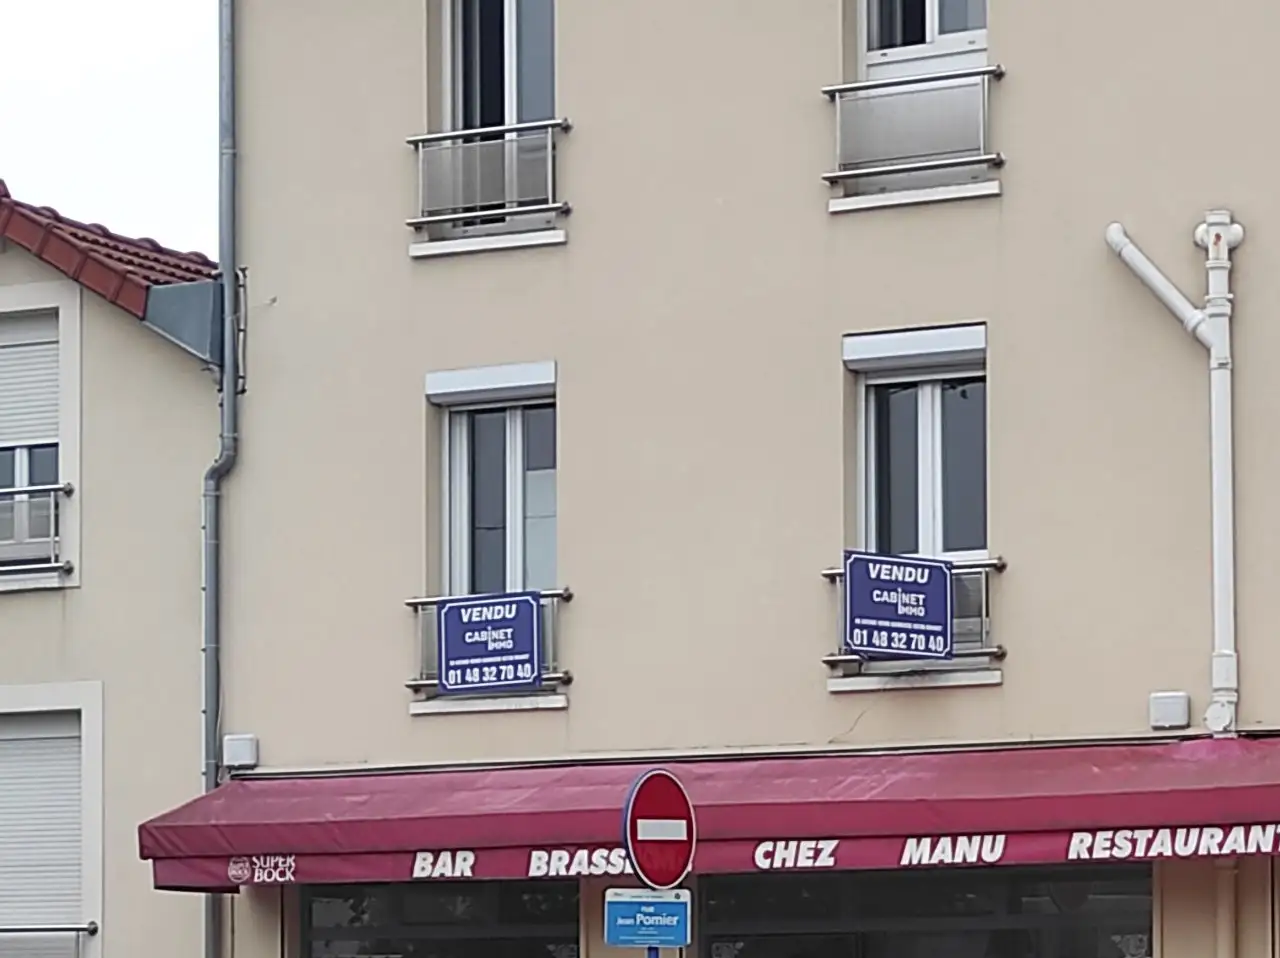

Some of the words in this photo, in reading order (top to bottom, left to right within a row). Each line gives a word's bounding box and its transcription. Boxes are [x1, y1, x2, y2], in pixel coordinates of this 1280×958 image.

[868, 562, 929, 584] VENDU
[461, 604, 517, 622] VENDU
[853, 629, 868, 645] 01
[872, 630, 888, 647] 48
[891, 632, 907, 649] 32
[909, 634, 925, 650] 70
[928, 635, 944, 652] 40
[448, 669, 461, 684] 01
[465, 667, 480, 682] 48
[482, 666, 497, 681] 32
[499, 665, 514, 680] 70
[517, 663, 532, 678] 40
[252, 855, 296, 868] SUPER
[413, 850, 475, 878] BAR
[528, 847, 692, 877] BRASS
[754, 839, 840, 869] CHEZ
[900, 834, 1006, 865] MANU
[254, 868, 295, 882] BOCK
[636, 912, 679, 926] Pomier
